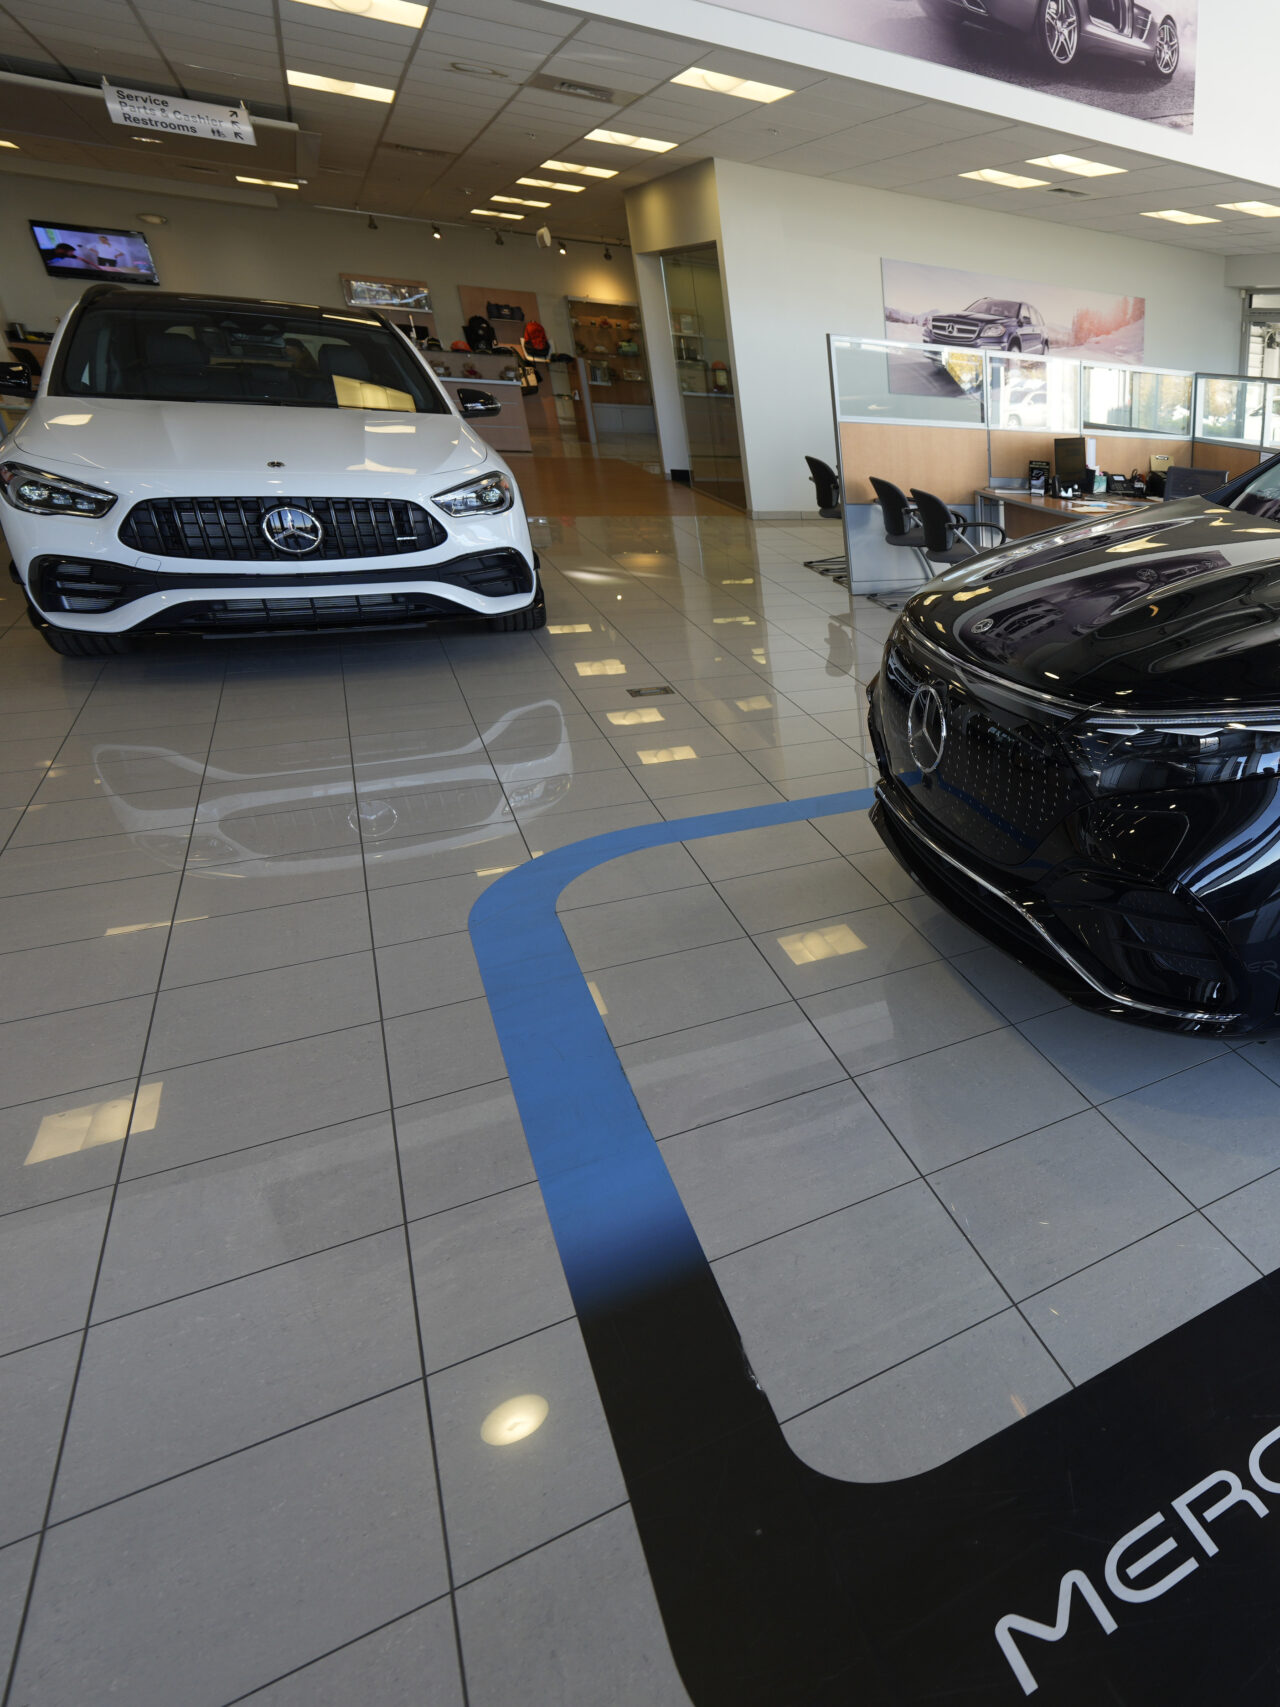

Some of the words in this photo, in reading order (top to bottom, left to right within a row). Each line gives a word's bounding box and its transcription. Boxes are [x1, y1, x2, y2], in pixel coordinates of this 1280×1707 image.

[116, 90, 169, 108] Service
[119, 101, 156, 117] Parts
[160, 108, 169, 118] &
[173, 110, 223, 126] Cashier
[122, 112, 198, 134] Restrooms
